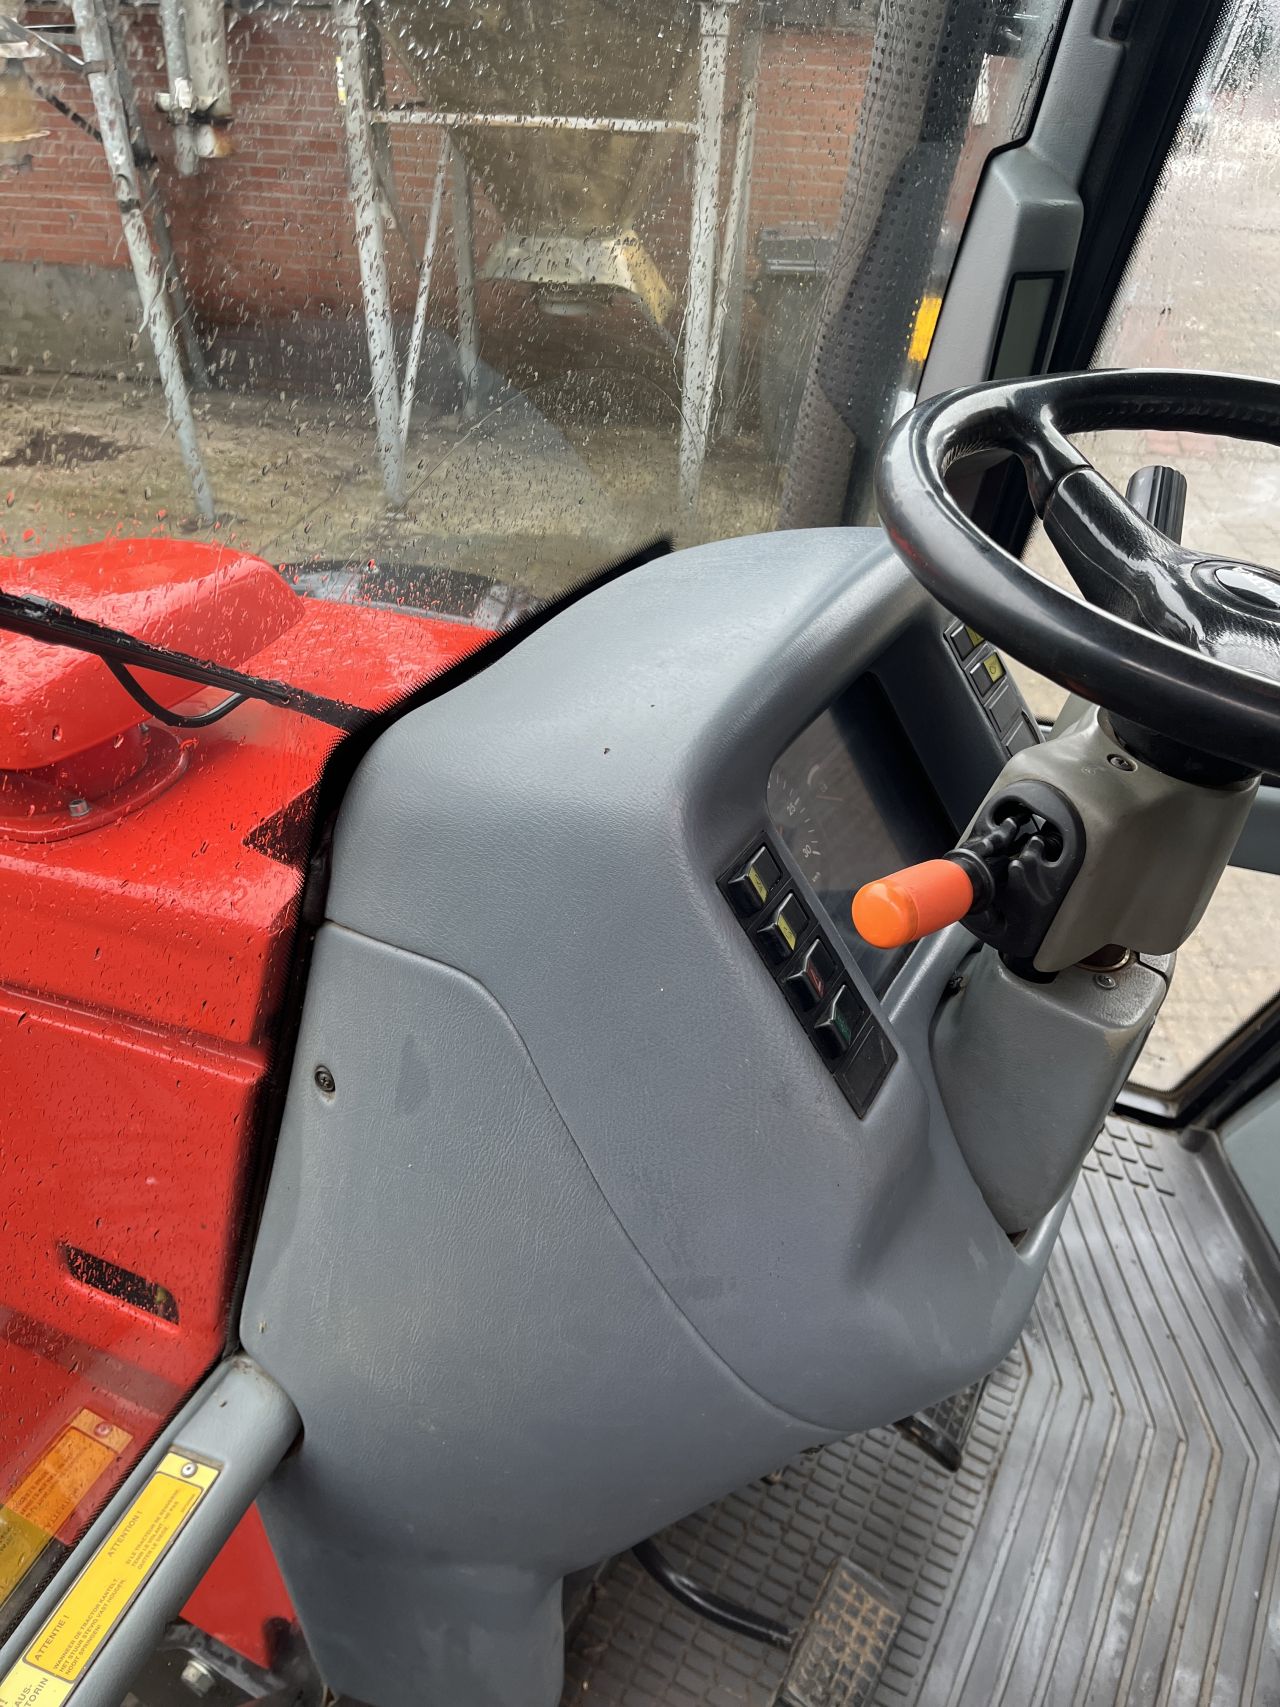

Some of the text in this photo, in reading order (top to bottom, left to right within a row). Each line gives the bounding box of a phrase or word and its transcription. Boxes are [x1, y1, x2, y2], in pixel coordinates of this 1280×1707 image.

[803, 845, 812, 858] 30
[108, 1515, 139, 1557] ATTENTION
[35, 1618, 66, 1661] ATTENTIE
[54, 1638, 77, 1669] WANNEER
[81, 1602, 101, 1630] TRACTOR
[59, 1659, 70, 1673] HET
[68, 1638, 84, 1660] STUUR
[97, 1602, 108, 1618] VAST
[65, 1655, 80, 1675] NOOIT
